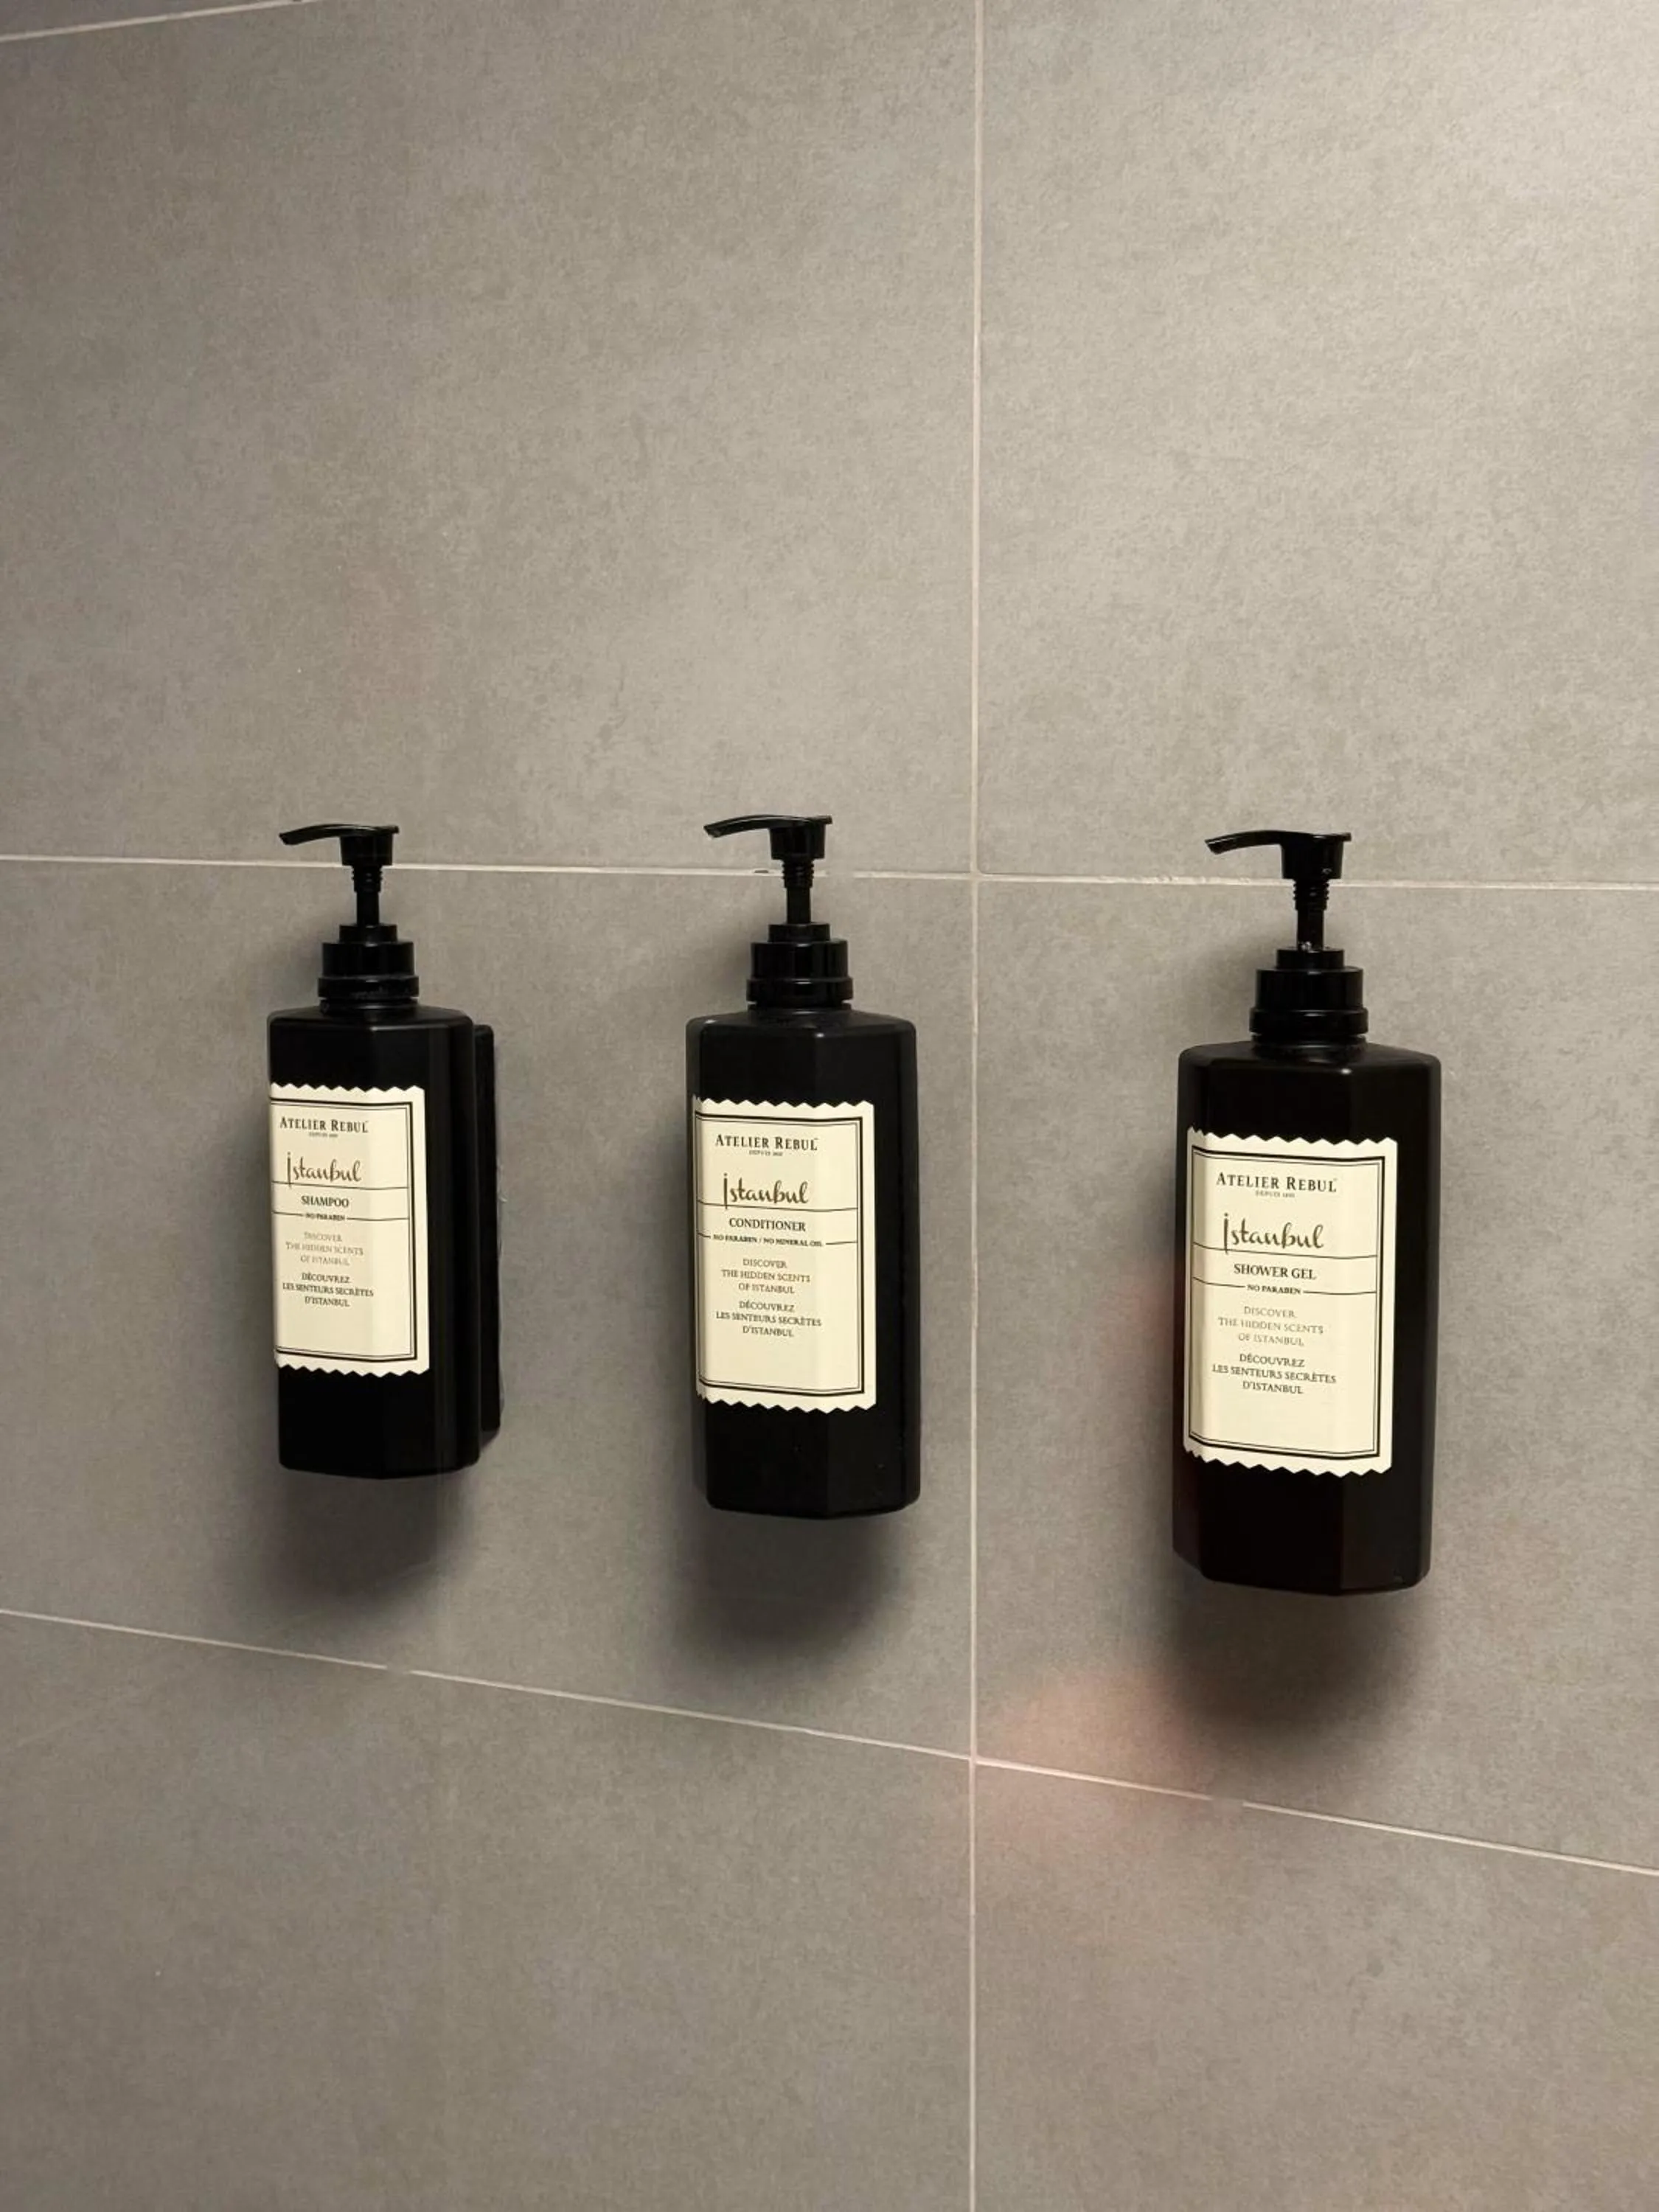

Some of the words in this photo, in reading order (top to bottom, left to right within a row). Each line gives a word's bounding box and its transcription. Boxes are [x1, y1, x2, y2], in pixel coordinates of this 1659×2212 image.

[279, 1116, 327, 1130] ATELIER
[331, 1119, 369, 1133] REBUL
[715, 1134, 769, 1149] ATELIER
[775, 1136, 818, 1151] REBUL
[1216, 1172, 1279, 1189] ATELIER
[1286, 1176, 1337, 1192] REBUL
[301, 1195, 350, 1208] SHAMPOO
[728, 1218, 806, 1232] CONDITIONER
[304, 1231, 343, 1242] DISCOVER
[712, 1234, 724, 1242] NO
[724, 1235, 757, 1243] PARABEN
[775, 1237, 807, 1246] MINERAL
[285, 1242, 300, 1250] THE
[302, 1242, 333, 1253] HIDDEN
[334, 1245, 364, 1256] SCENTS
[311, 1256, 350, 1266] ISTANBUL
[742, 1258, 787, 1269] DISCOVER
[301, 1272, 350, 1284] DÉCOUVREZ
[721, 1269, 739, 1279] THE
[740, 1270, 776, 1281] HIDDEN
[777, 1273, 810, 1283] SCENTS
[1234, 1263, 1289, 1278] SHOWER
[1291, 1267, 1317, 1280] GEL
[282, 1282, 294, 1290] LES
[294, 1284, 335, 1294] SENTEURS
[738, 1283, 750, 1292] OF
[751, 1284, 795, 1294] ISTANBUL
[1247, 1284, 1260, 1292] NO
[1262, 1284, 1301, 1295] PARABEN
[305, 1296, 350, 1307] D'ISTANBUL
[739, 1300, 796, 1312] DÉCOUVREZ
[716, 1311, 731, 1320] LES
[731, 1312, 776, 1324] SENTEURS
[1243, 1306, 1296, 1318] DISCOVER
[742, 1326, 795, 1338] D'ISTANBUL
[1218, 1317, 1239, 1327] THE
[1240, 1319, 1281, 1332] HIDDEN
[1283, 1323, 1324, 1335] SCENTS
[1238, 1333, 1252, 1342] OF
[1253, 1334, 1304, 1346] ISTANBUL
[1239, 1352, 1305, 1368] DÉCOUVREZ
[1212, 1364, 1228, 1374] LES
[1230, 1366, 1283, 1380] SENTEURS
[1284, 1369, 1337, 1383] SECRÈTES
[1242, 1380, 1304, 1394] D'ISTANBUL
